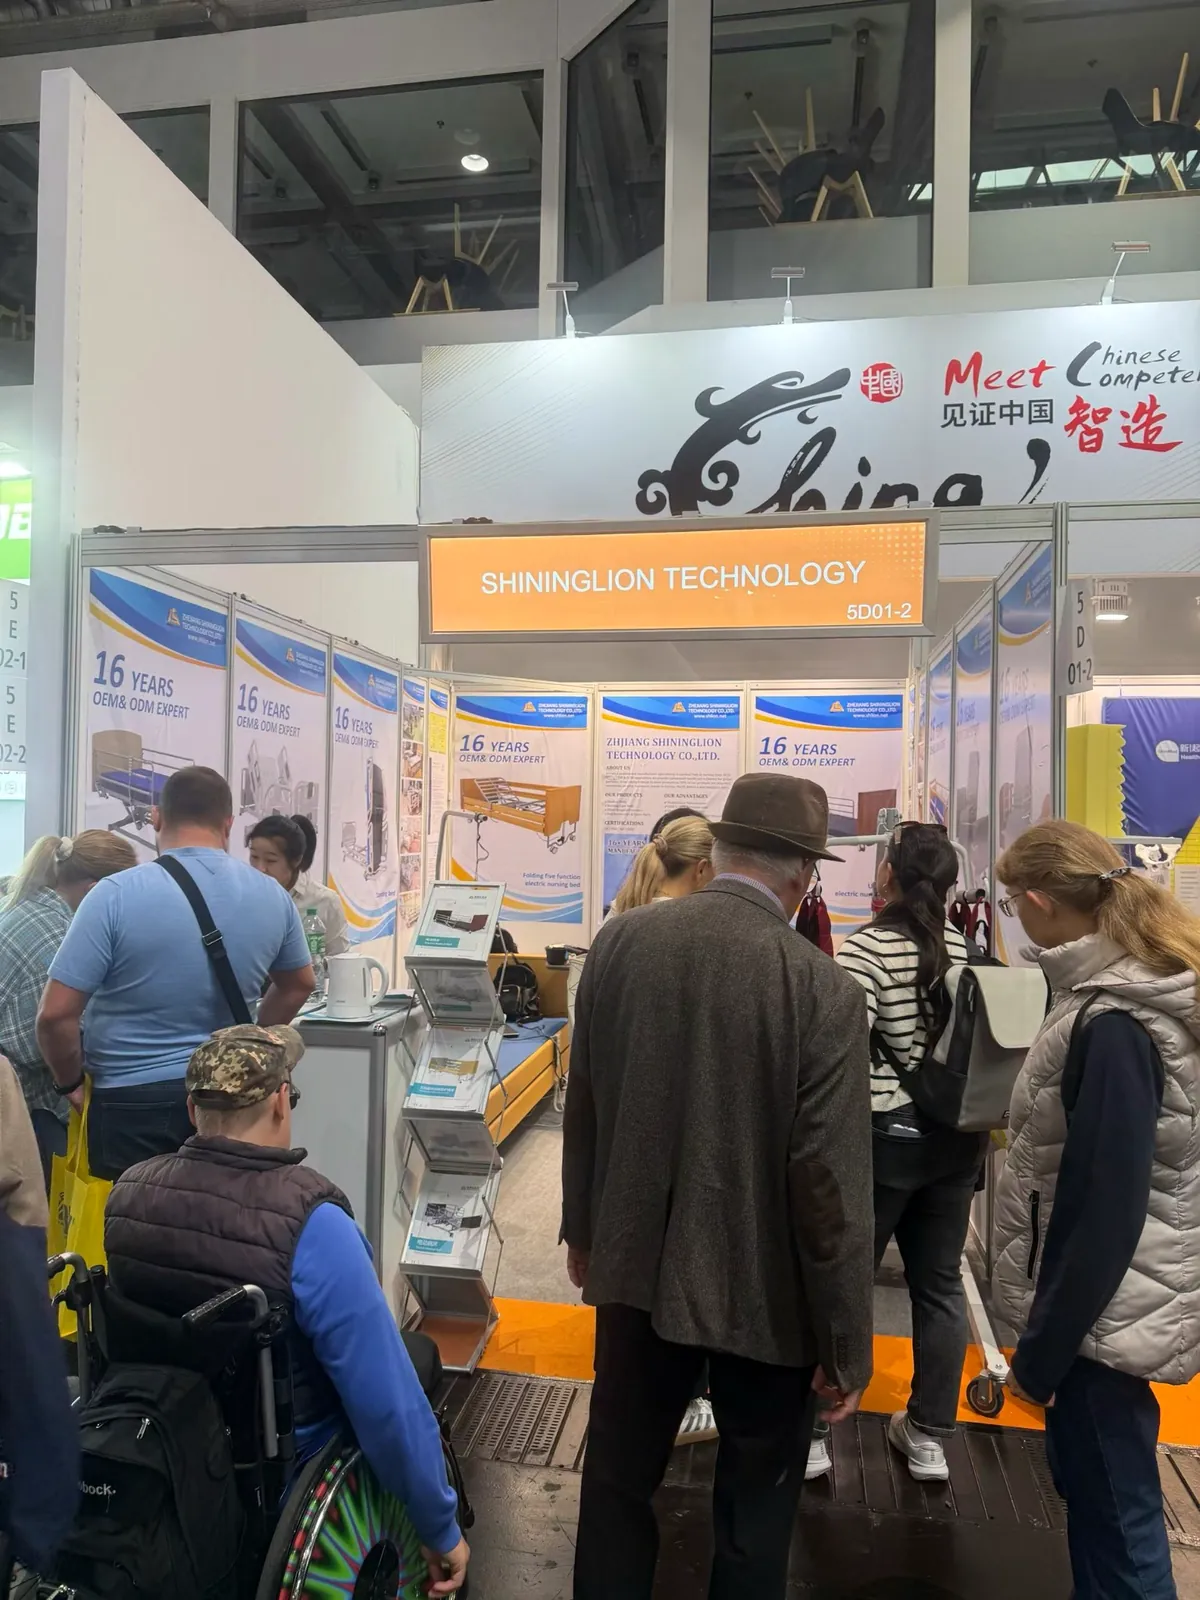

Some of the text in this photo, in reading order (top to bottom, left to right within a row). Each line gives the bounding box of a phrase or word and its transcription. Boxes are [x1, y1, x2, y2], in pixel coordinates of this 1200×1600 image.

[944, 351, 1056, 398] Meet
[941, 394, 1183, 453] 见证中国 智造
[481, 560, 866, 594] SHININGLION TECHNOLOGY
[10, 591, 18, 610] 5
[1077, 591, 1084, 614] 5
[846, 603, 912, 621] 5D01-2
[9, 619, 17, 639] E
[1077, 626, 1085, 648] D
[93, 650, 174, 698] 16 YEARS
[1068, 658, 1092, 685] 01-2
[6, 686, 15, 704] 5
[237, 683, 291, 720] 16 YEARS
[92, 691, 190, 719] OEM& ODM EXPERT
[7, 715, 15, 733] E
[236, 715, 300, 738] OEM& ODM EXPERT
[335, 706, 373, 735] 16 YEARS
[460, 734, 530, 752] 16 YEARS
[606, 737, 722, 748] ZHJIANG SHININGLION
[759, 736, 837, 755] 16 YEARS
[459, 754, 546, 763] OEM& ODM EXPERT
[606, 750, 676, 760] TECHNOLOGY
[758, 757, 856, 766] OEM& ODM EXPERT
[522, 872, 544, 880] Folding
[547, 881, 569, 889] nursing
[834, 890, 859, 898] electric
